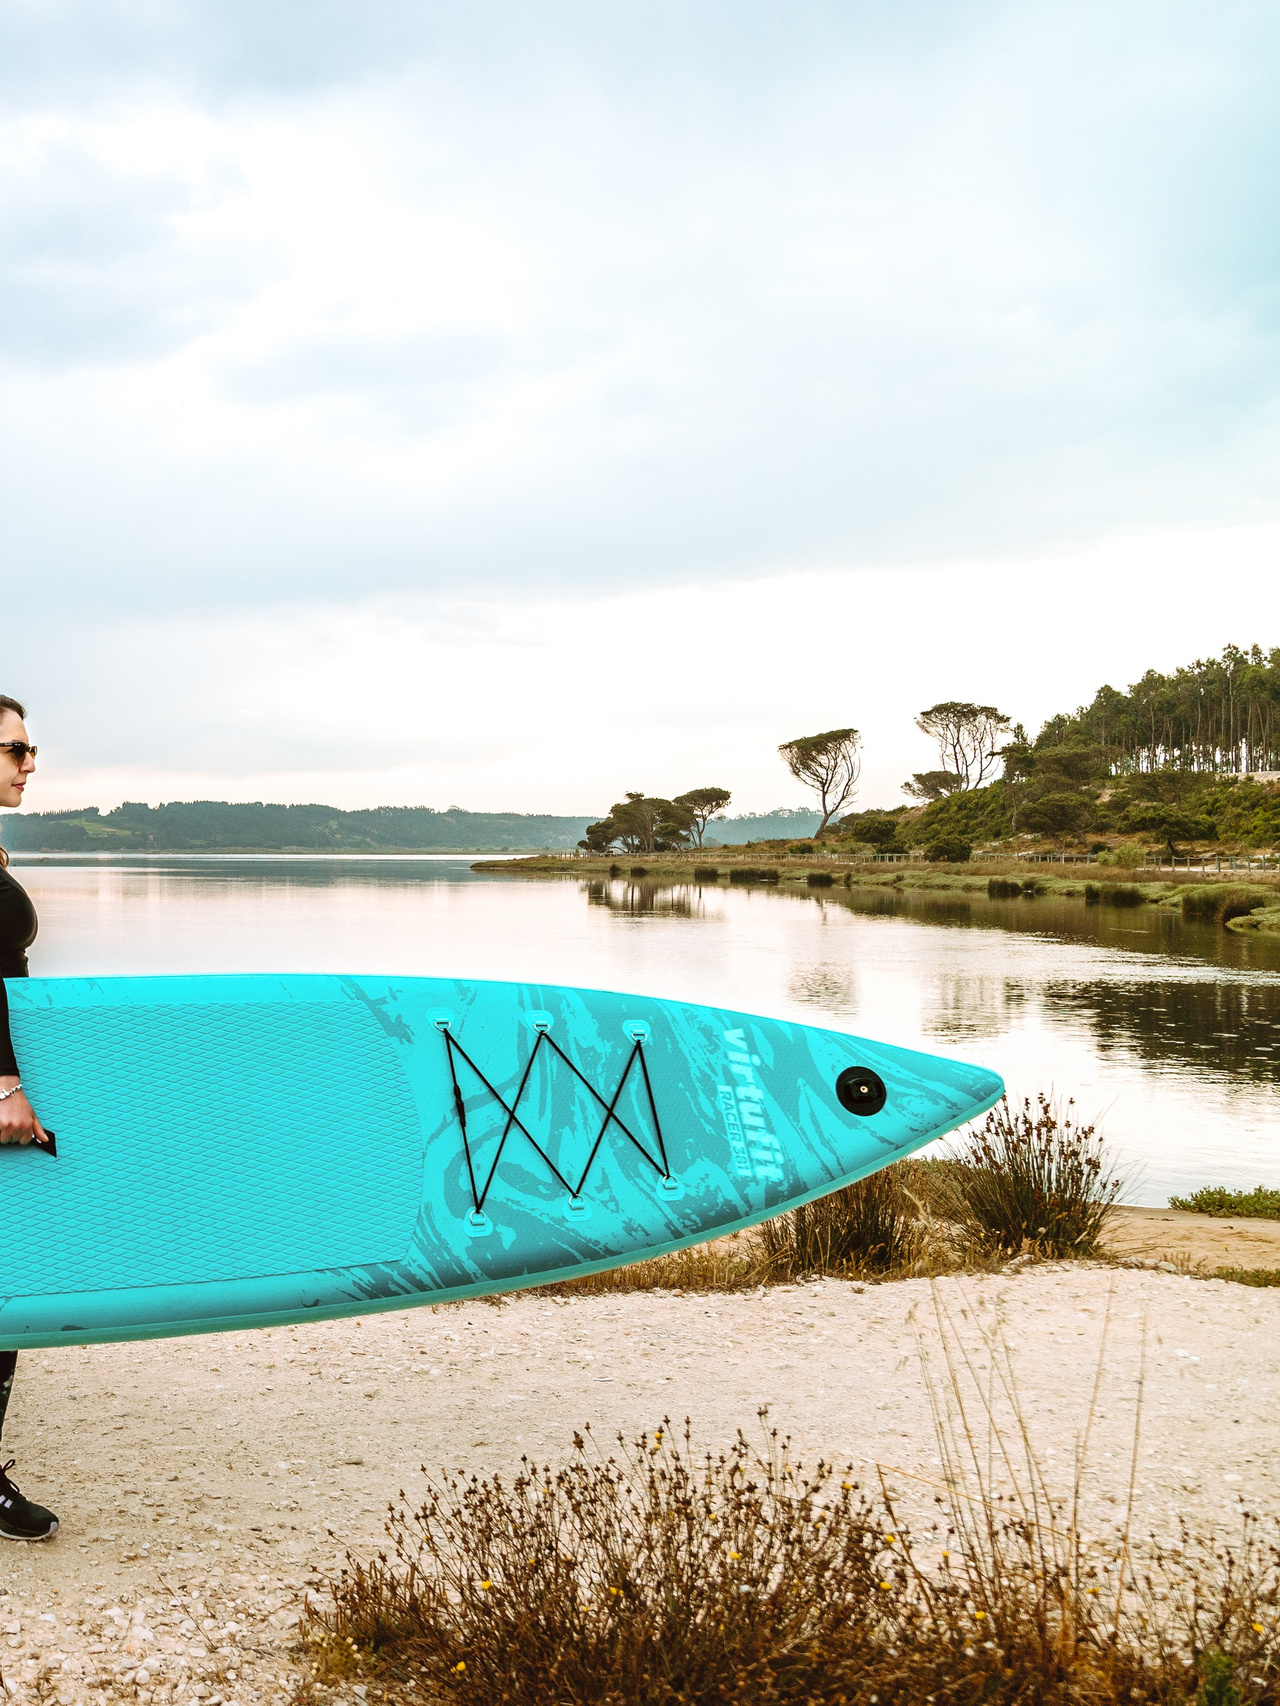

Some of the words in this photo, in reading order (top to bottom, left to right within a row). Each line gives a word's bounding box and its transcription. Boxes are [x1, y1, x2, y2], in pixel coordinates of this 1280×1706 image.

[720, 1091, 742, 1142] RACER
[733, 1146, 750, 1170] 381
[723, 1028, 784, 1182] virtufit
